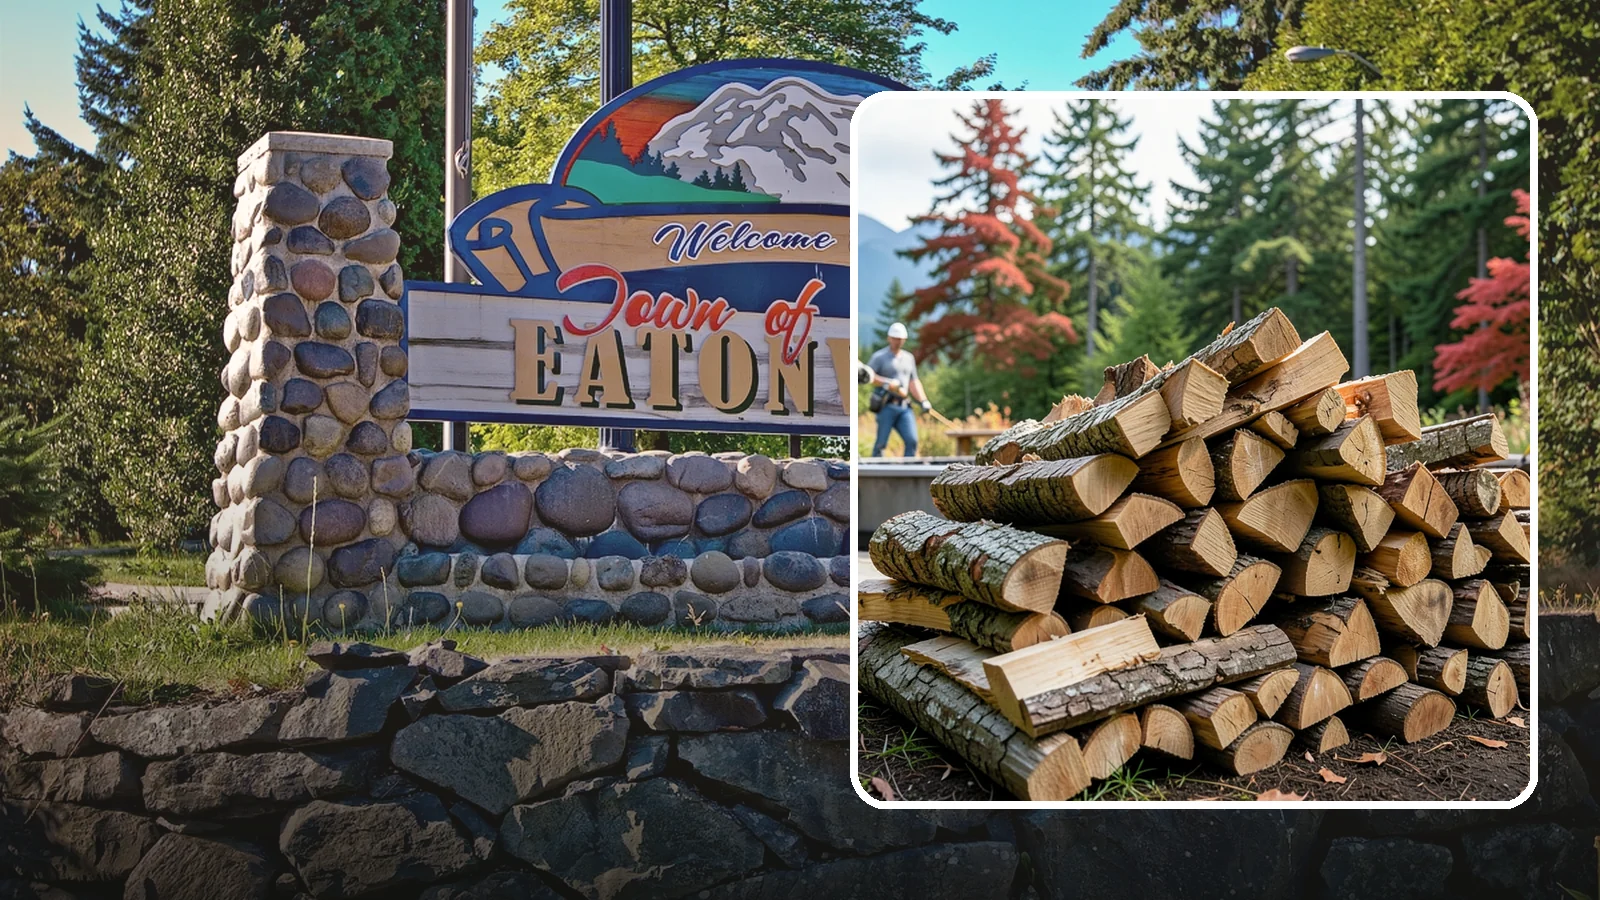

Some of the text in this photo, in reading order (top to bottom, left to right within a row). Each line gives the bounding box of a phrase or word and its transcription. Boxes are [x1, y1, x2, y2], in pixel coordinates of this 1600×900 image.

[653, 221, 837, 263] Welcome
[556, 263, 826, 365] Town of
